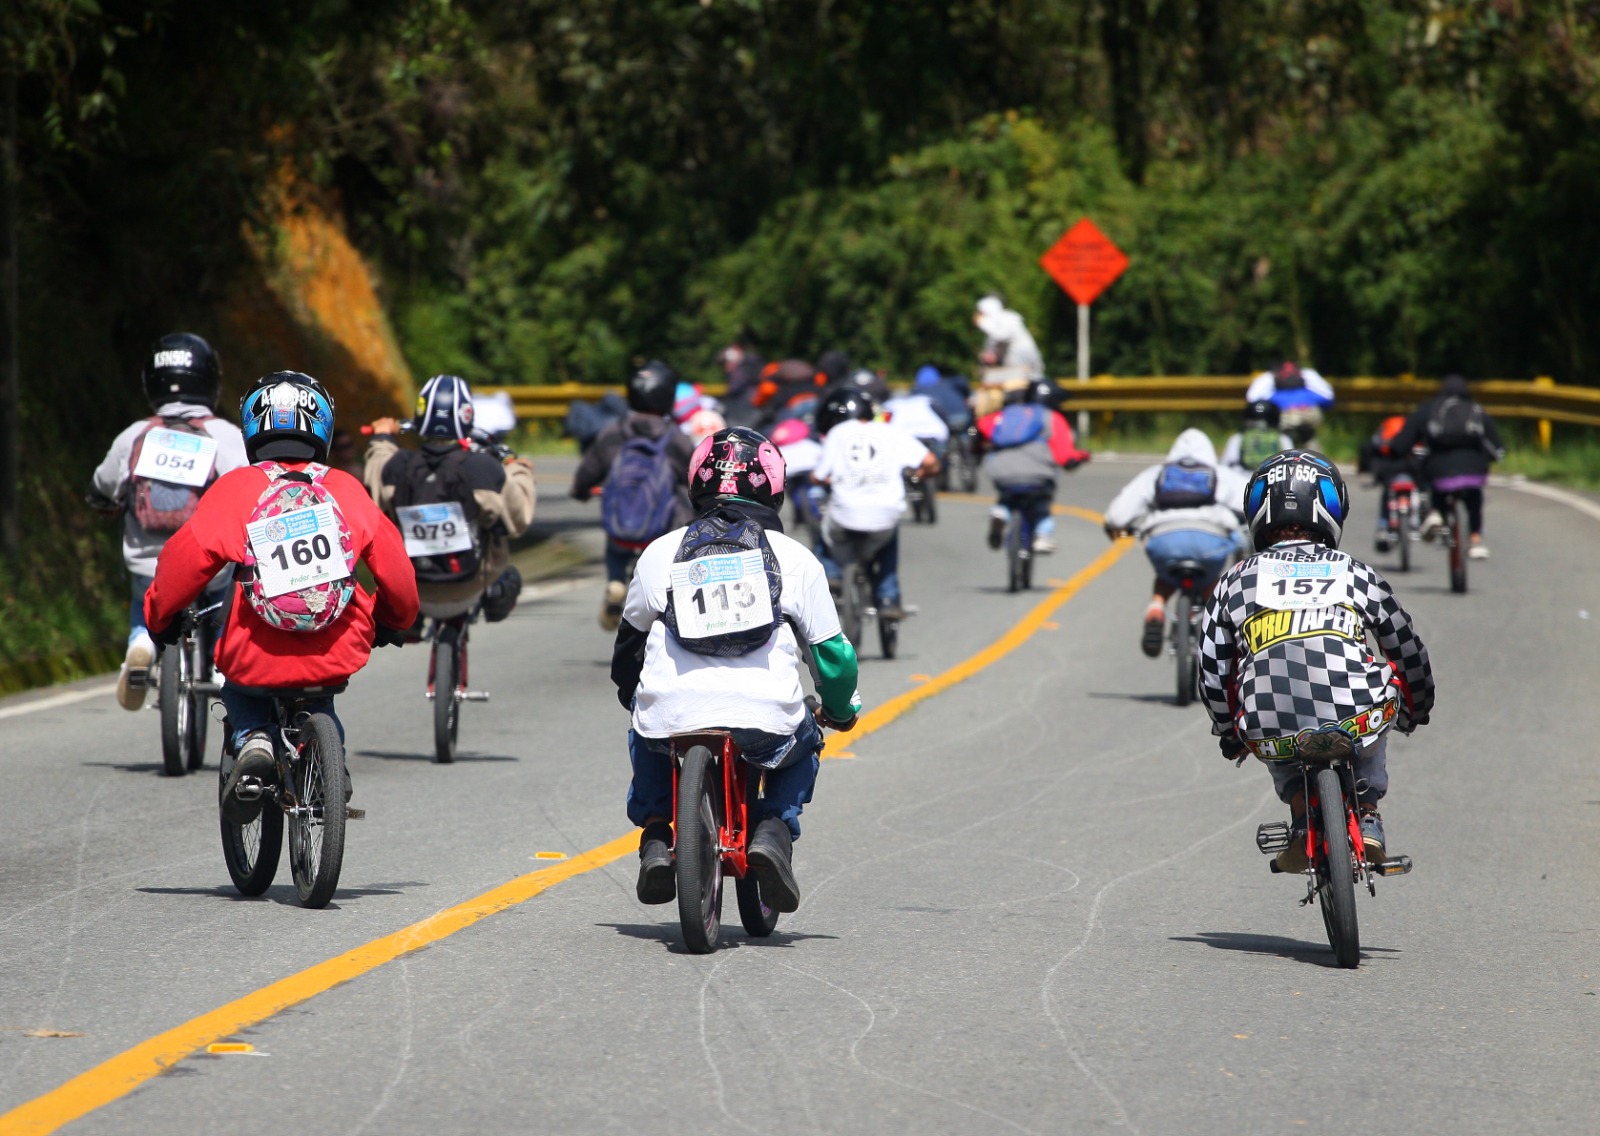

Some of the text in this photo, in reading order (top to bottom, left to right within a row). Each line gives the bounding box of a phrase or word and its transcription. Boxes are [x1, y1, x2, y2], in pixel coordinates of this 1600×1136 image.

[155, 454, 195, 470] 054
[1267, 464, 1287, 485] GEI
[286, 511, 313, 522] Festival
[412, 521, 456, 540] 079
[270, 534, 331, 570] 160
[708, 558, 738, 566] Festival
[1271, 579, 1336, 595] 157
[691, 582, 756, 615] 113
